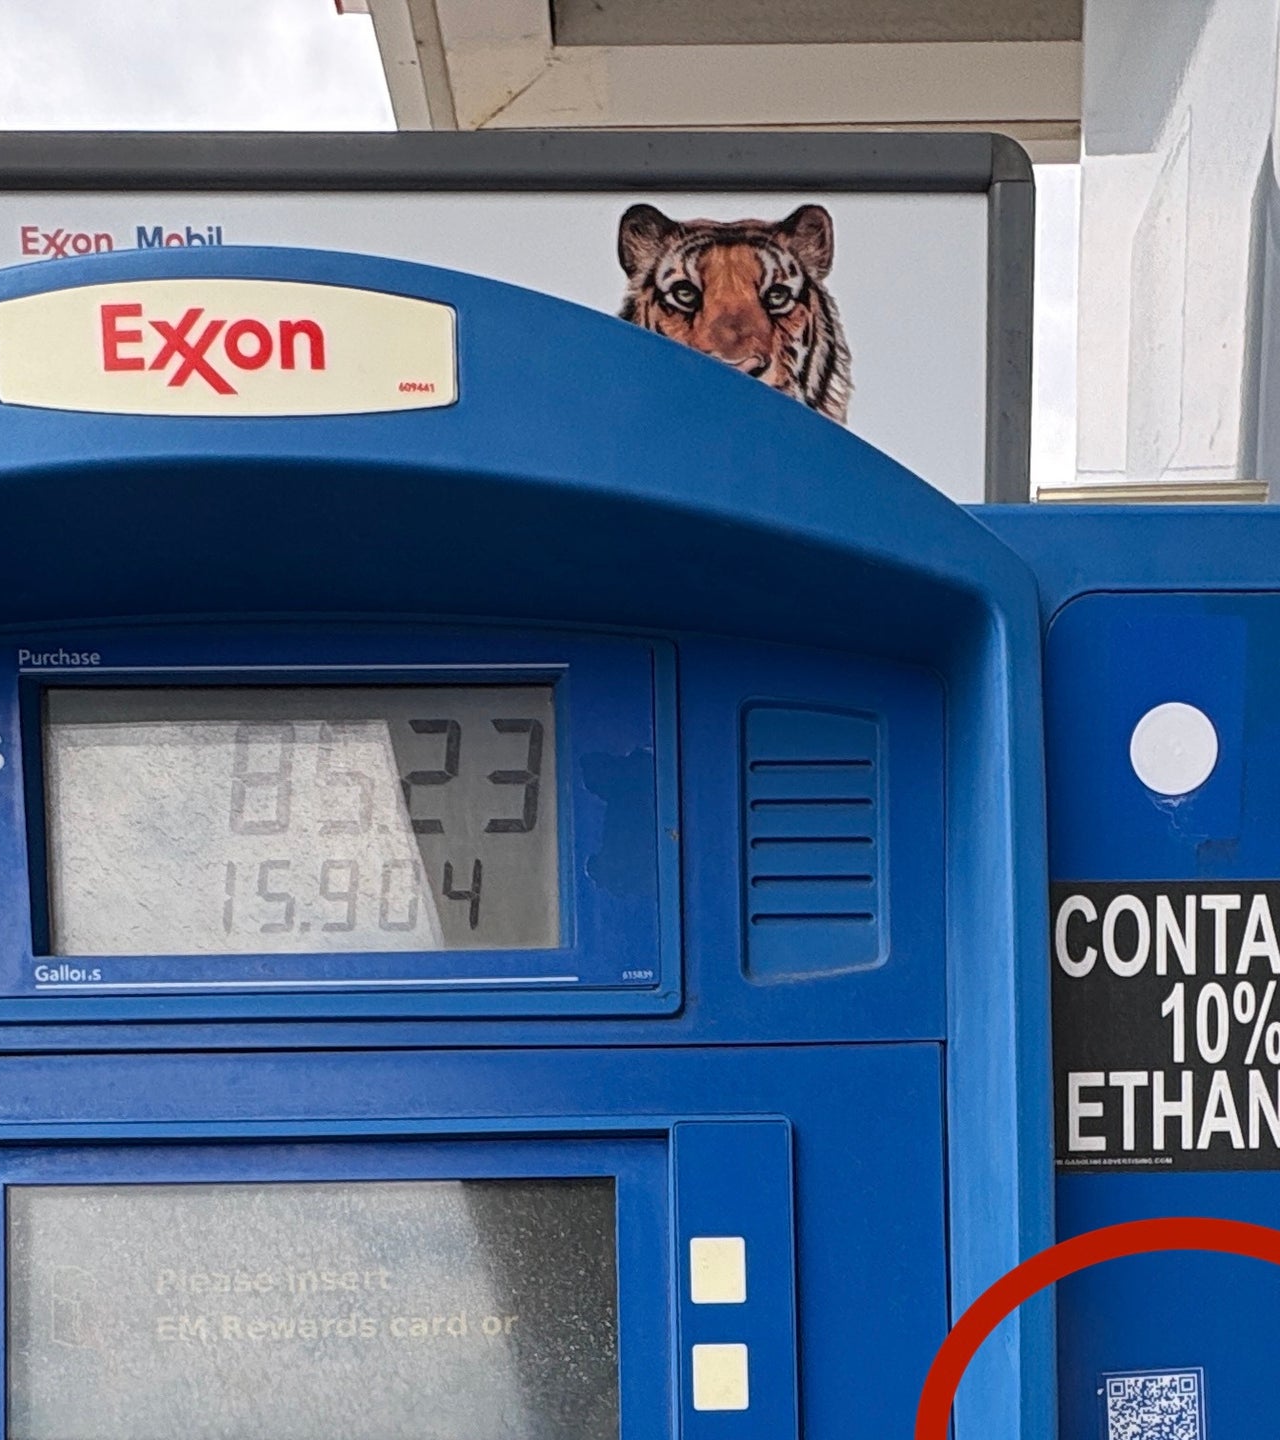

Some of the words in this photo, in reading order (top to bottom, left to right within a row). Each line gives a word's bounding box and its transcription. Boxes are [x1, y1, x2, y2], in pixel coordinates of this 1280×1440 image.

[22, 227, 112, 260] Exxon
[101, 305, 325, 394] Exxon
[19, 649, 101, 666] Purchase
[156, 1269, 275, 1295] Please
[223, 1313, 377, 1338] Rewards
[390, 1311, 468, 1336] card
[481, 1314, 518, 1334] or
